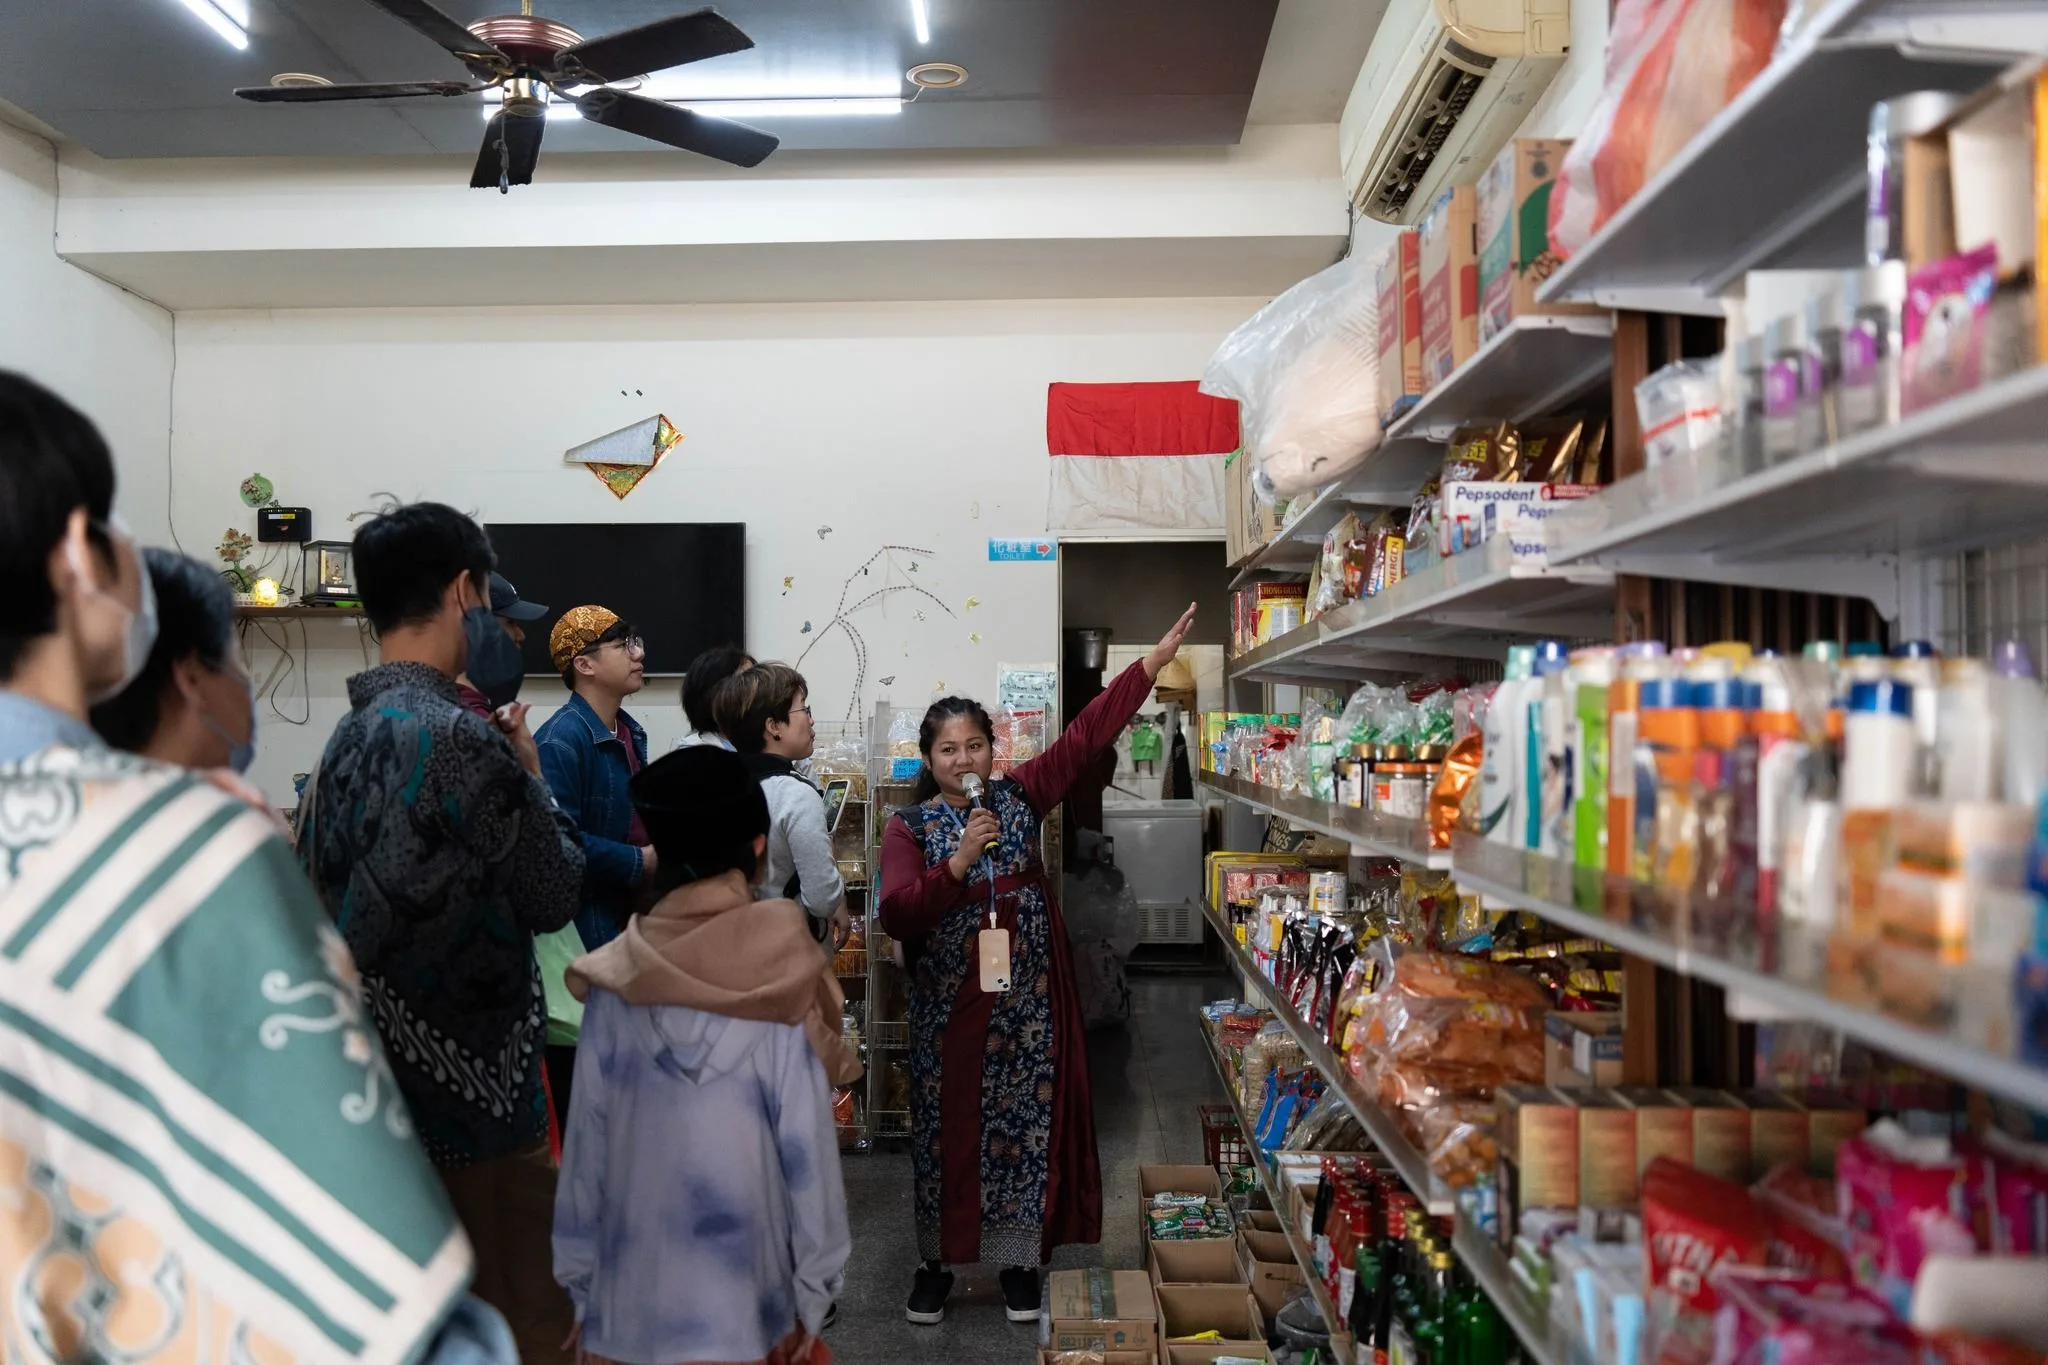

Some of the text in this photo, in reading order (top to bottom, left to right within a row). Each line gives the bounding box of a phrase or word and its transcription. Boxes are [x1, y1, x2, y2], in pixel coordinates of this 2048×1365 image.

[1455, 486, 1535, 503] Pepsodent
[999, 552, 1025, 560] TOILET
[1390, 541, 1399, 584] NERGEN
[1260, 586, 1283, 595] KHONG
